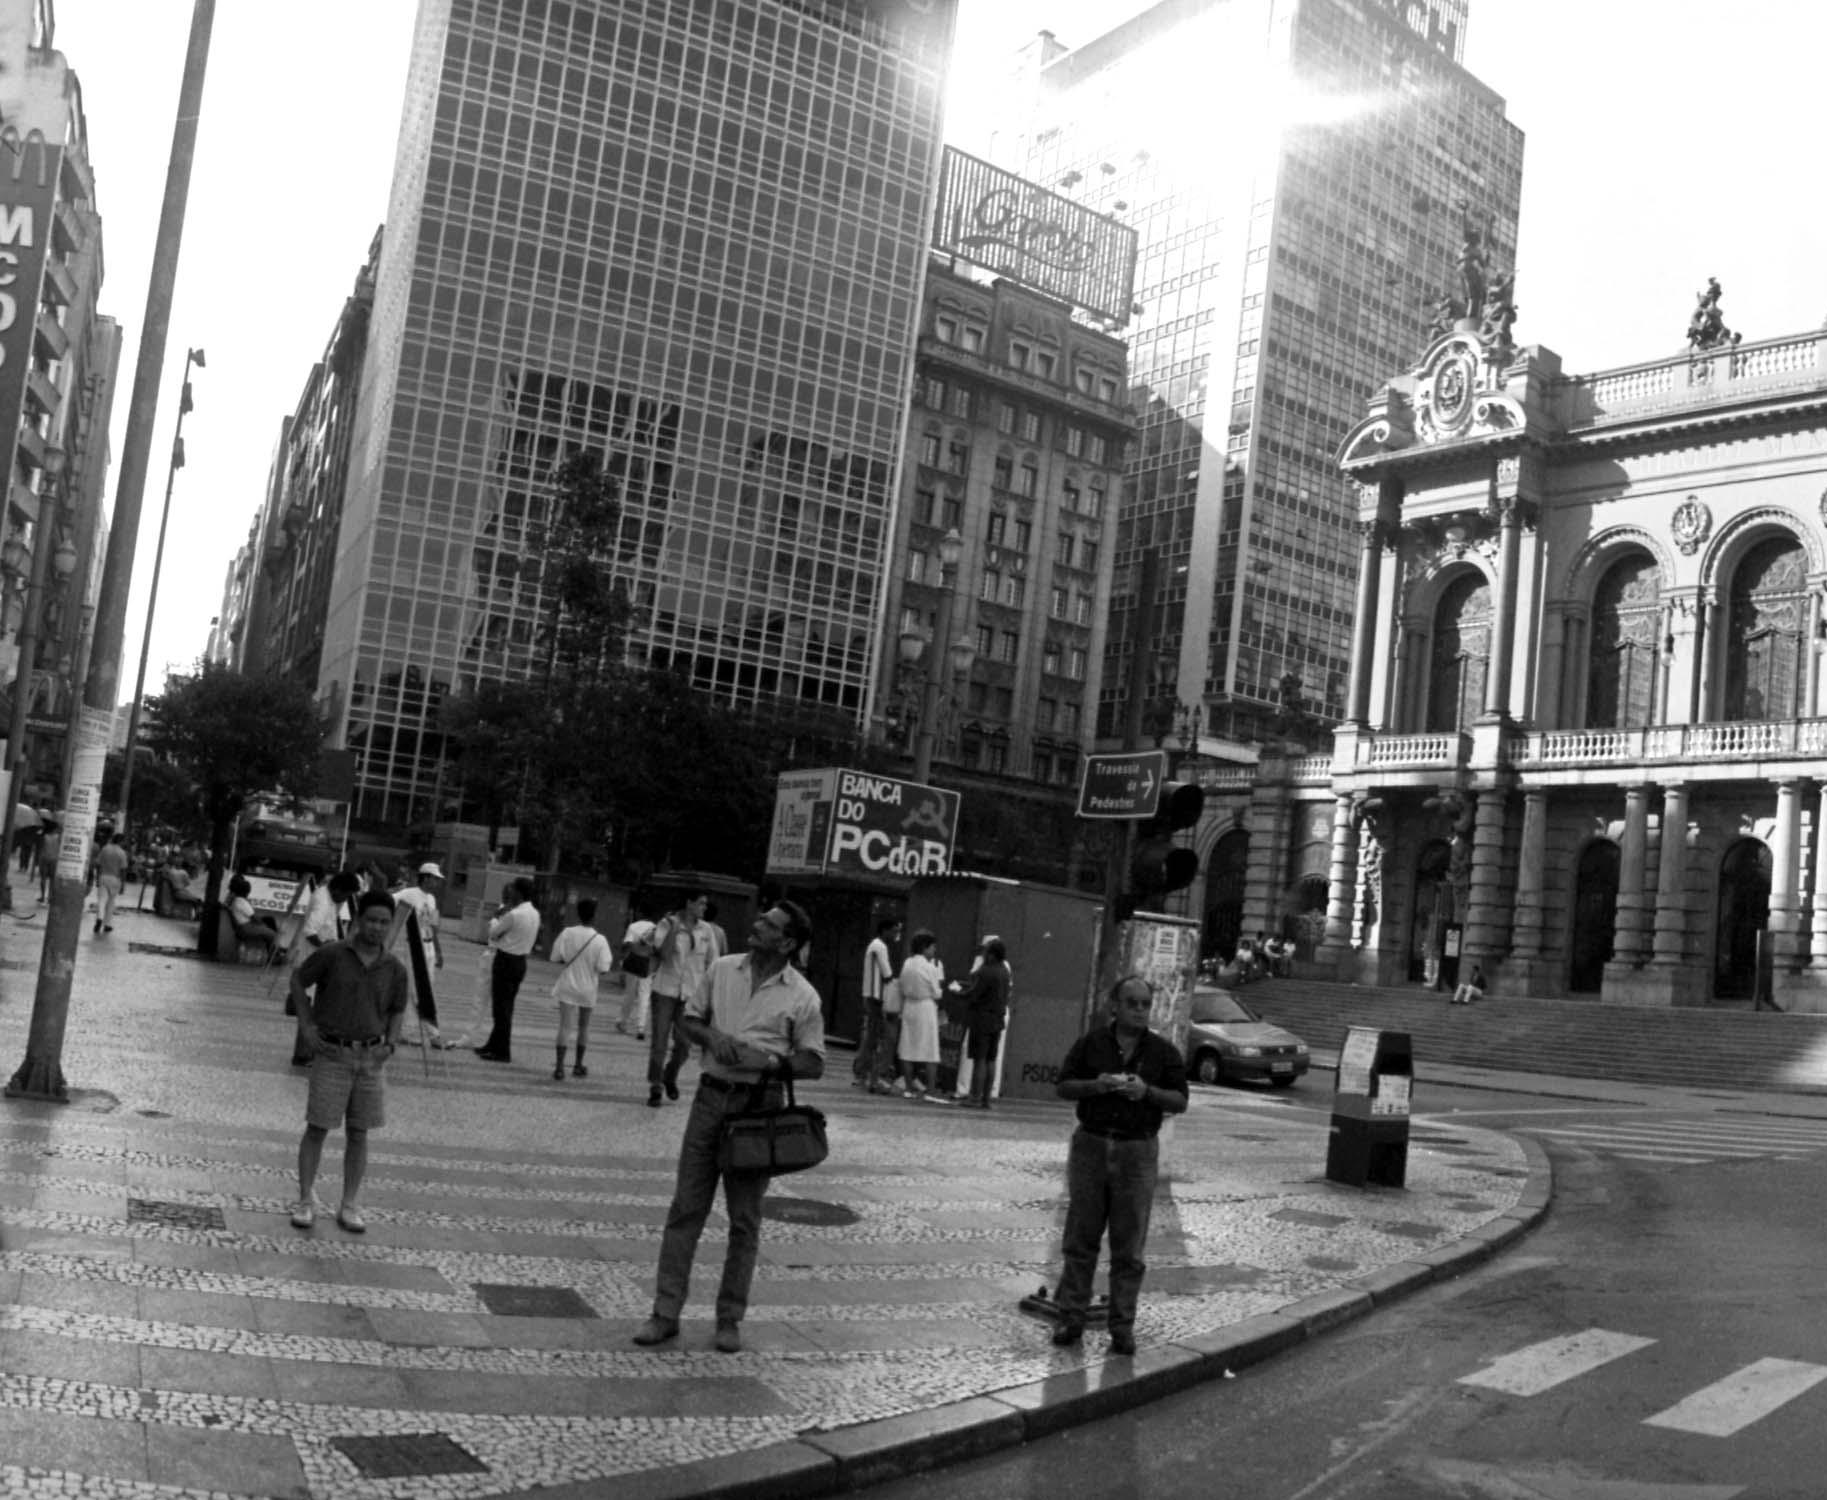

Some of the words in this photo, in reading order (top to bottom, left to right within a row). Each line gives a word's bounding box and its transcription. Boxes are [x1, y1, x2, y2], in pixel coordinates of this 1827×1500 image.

[841, 774, 902, 805] BANCA
[838, 799, 865, 821] DO
[831, 823, 947, 875] PCdoB
